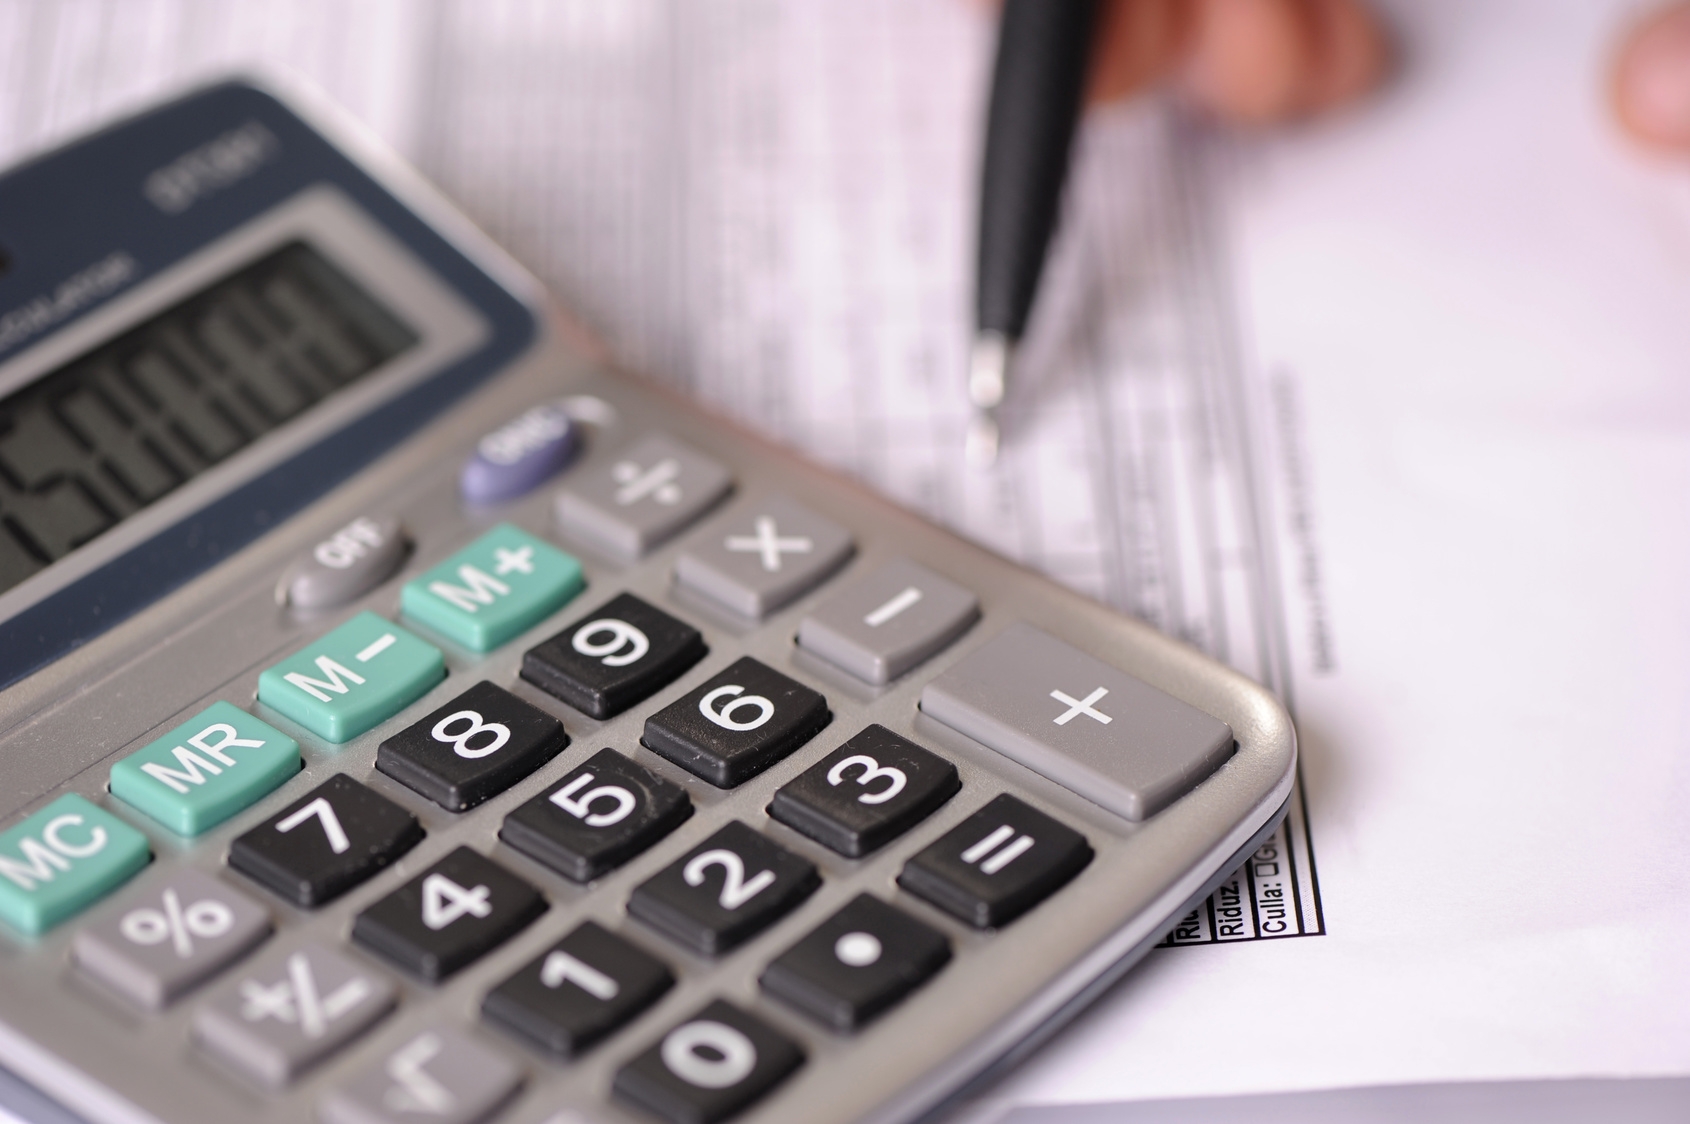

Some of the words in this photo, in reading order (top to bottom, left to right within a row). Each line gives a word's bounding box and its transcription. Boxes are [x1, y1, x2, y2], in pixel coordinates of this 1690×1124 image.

[314, 516, 383, 569] OFF
[430, 547, 533, 612] M+
[573, 620, 649, 666] 9
[432, 711, 510, 758] 8
[699, 685, 774, 731] 6
[142, 723, 265, 793] MR
[828, 755, 906, 803] 3
[276, 798, 349, 853] 7
[550, 773, 635, 826] 5
[0, 814, 107, 889] MC
[423, 875, 490, 928] 4
[684, 850, 774, 908] 2
[1216, 880, 1245, 937] Riduz.
[1259, 882, 1287, 933] Culla:
[543, 952, 616, 998] 1
[663, 1022, 754, 1086] 0
